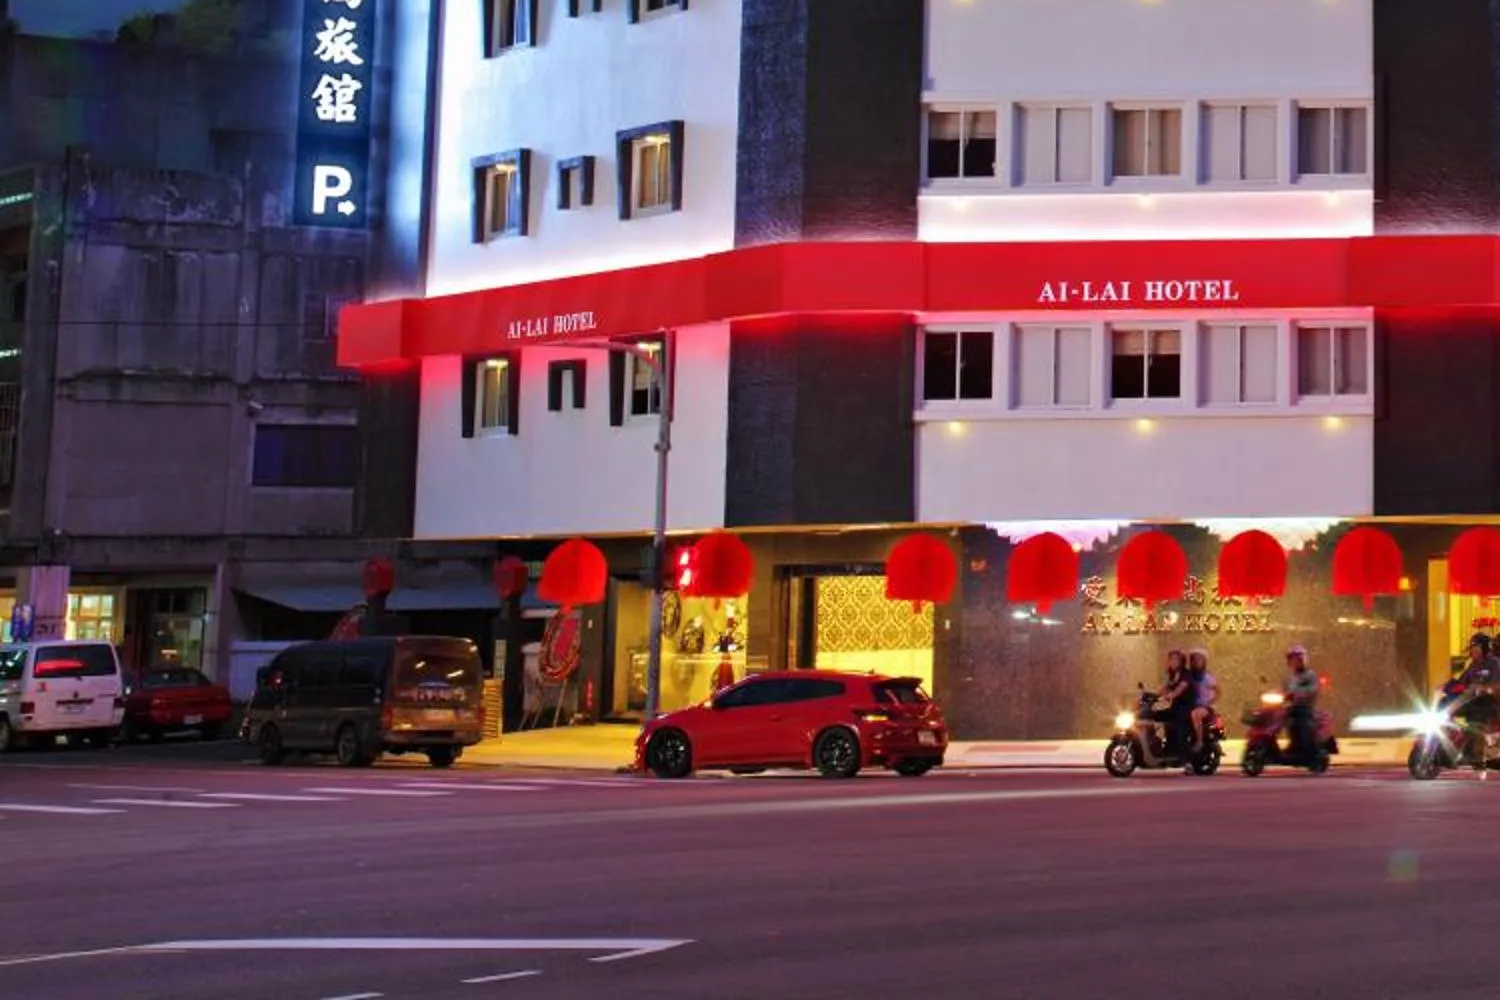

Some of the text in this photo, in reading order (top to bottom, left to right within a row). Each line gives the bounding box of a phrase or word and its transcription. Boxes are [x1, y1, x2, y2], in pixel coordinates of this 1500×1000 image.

[312, 166, 353, 215] P
[1037, 279, 1240, 302] AI-LAI HOTEL
[507, 311, 597, 339] AI-LAI HOTEL
